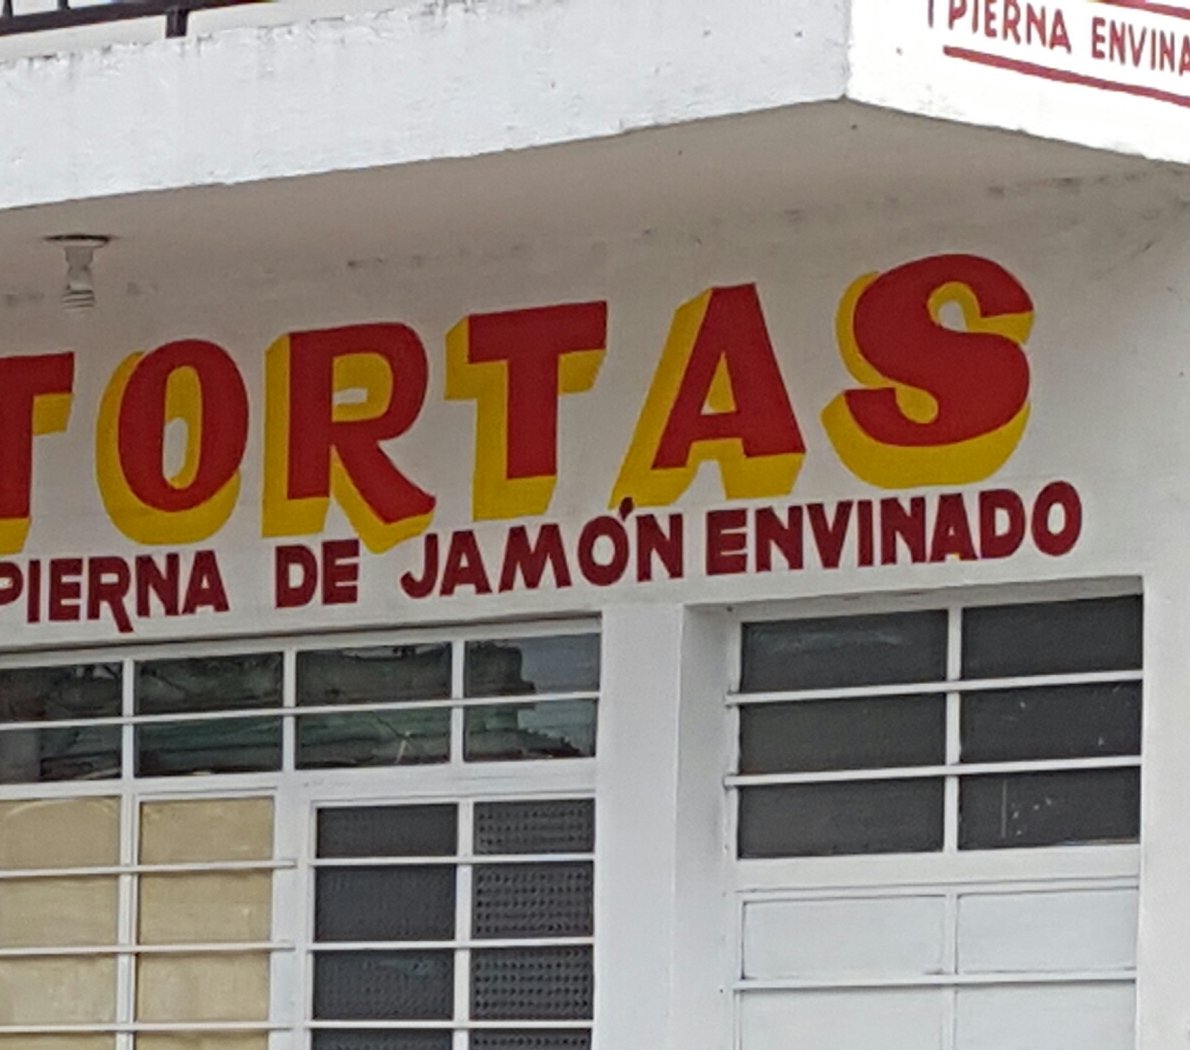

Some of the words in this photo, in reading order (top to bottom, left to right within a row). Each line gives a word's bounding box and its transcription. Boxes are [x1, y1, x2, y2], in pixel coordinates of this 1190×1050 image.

[948, 0, 1072, 54] PIERNA
[274, 538, 361, 610] DE
[400, 496, 684, 600] JAMÓN
[705, 480, 1083, 577] ENVINADO
